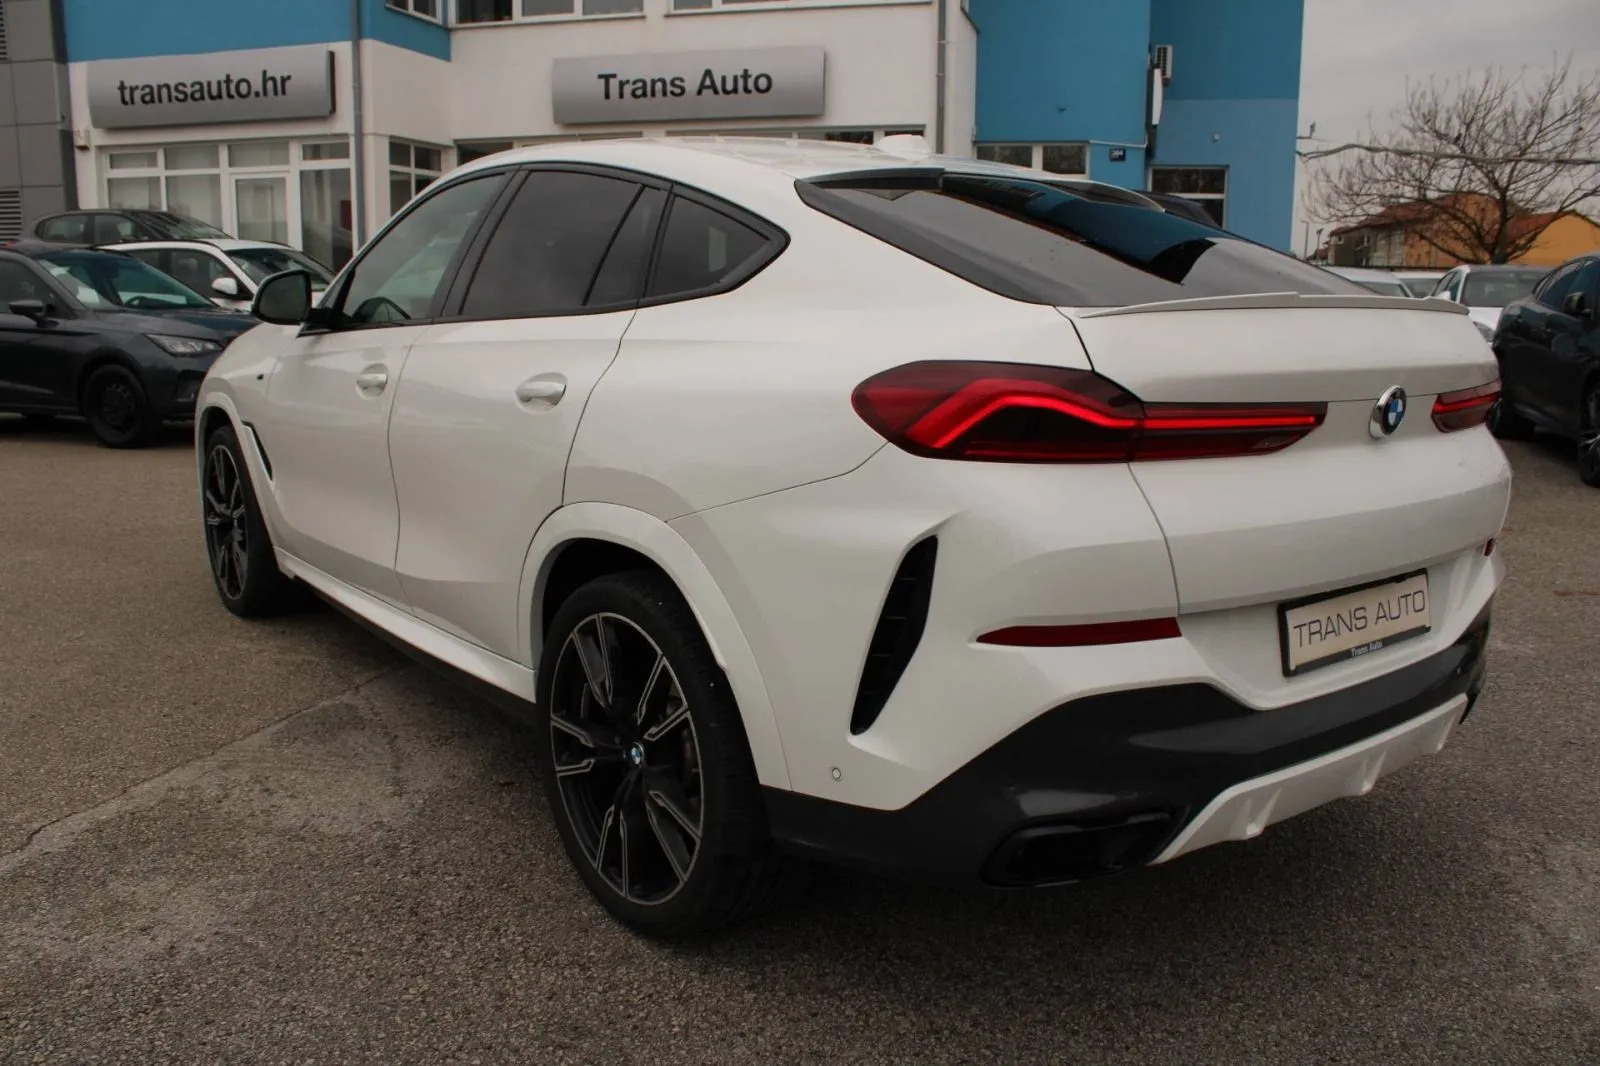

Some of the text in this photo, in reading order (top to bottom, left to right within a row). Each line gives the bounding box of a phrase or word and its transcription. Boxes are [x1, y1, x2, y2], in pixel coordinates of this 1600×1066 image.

[117, 69, 292, 106] transauto.hr
[598, 68, 773, 100] Trans Auto
[1293, 590, 1426, 648] TRANS AUTO
